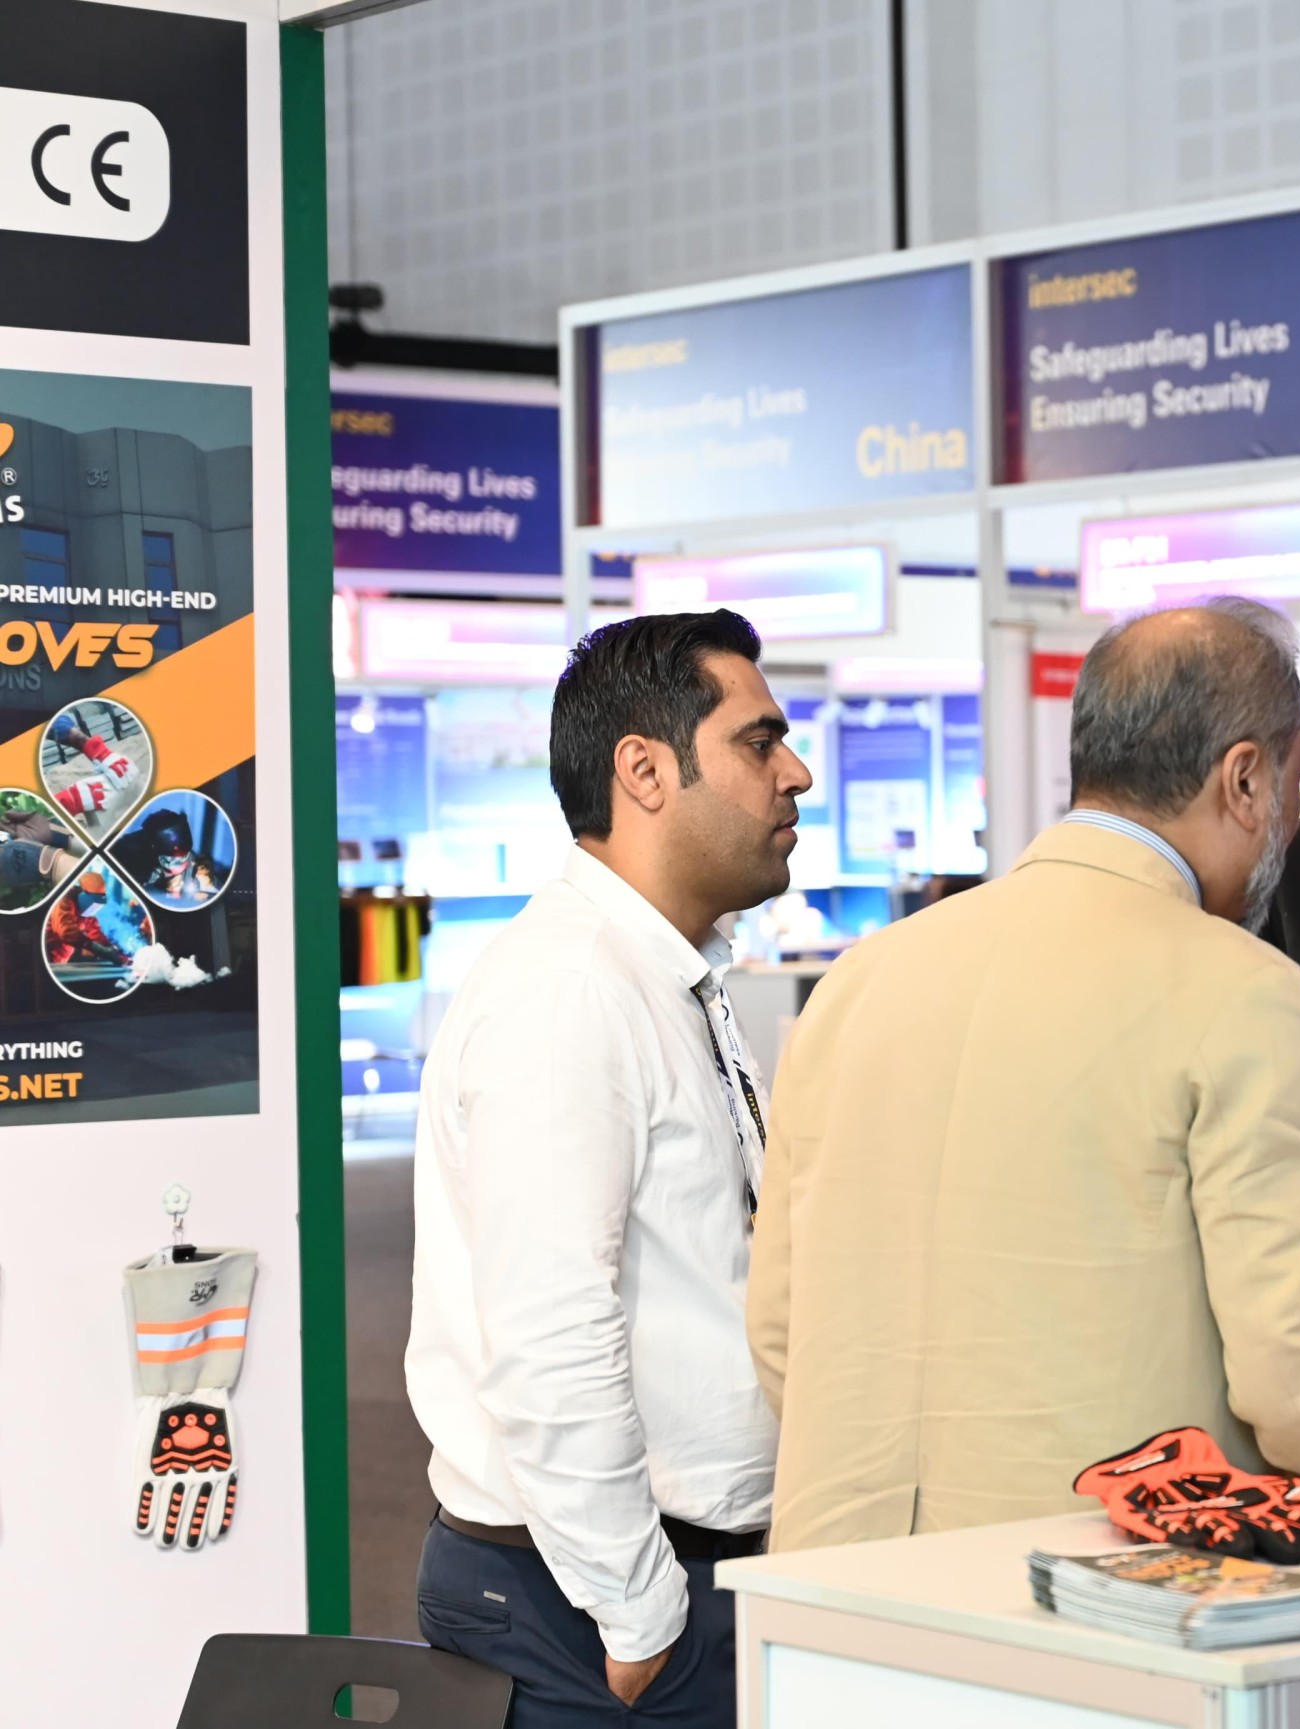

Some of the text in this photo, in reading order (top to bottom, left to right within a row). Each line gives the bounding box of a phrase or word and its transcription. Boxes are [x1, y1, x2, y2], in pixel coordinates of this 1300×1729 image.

[31, 124, 130, 212] CE
[1029, 266, 1137, 310] intersec
[1029, 318, 1290, 384] Safeguarding Lives
[1030, 372, 1270, 432] Ensuring Security
[856, 420, 967, 479] China
[468, 467, 537, 500] Lives
[410, 501, 520, 542] Security
[0, 584, 216, 609] PREMIUM HIGH-END
[0, 1041, 83, 1060] RYTHING
